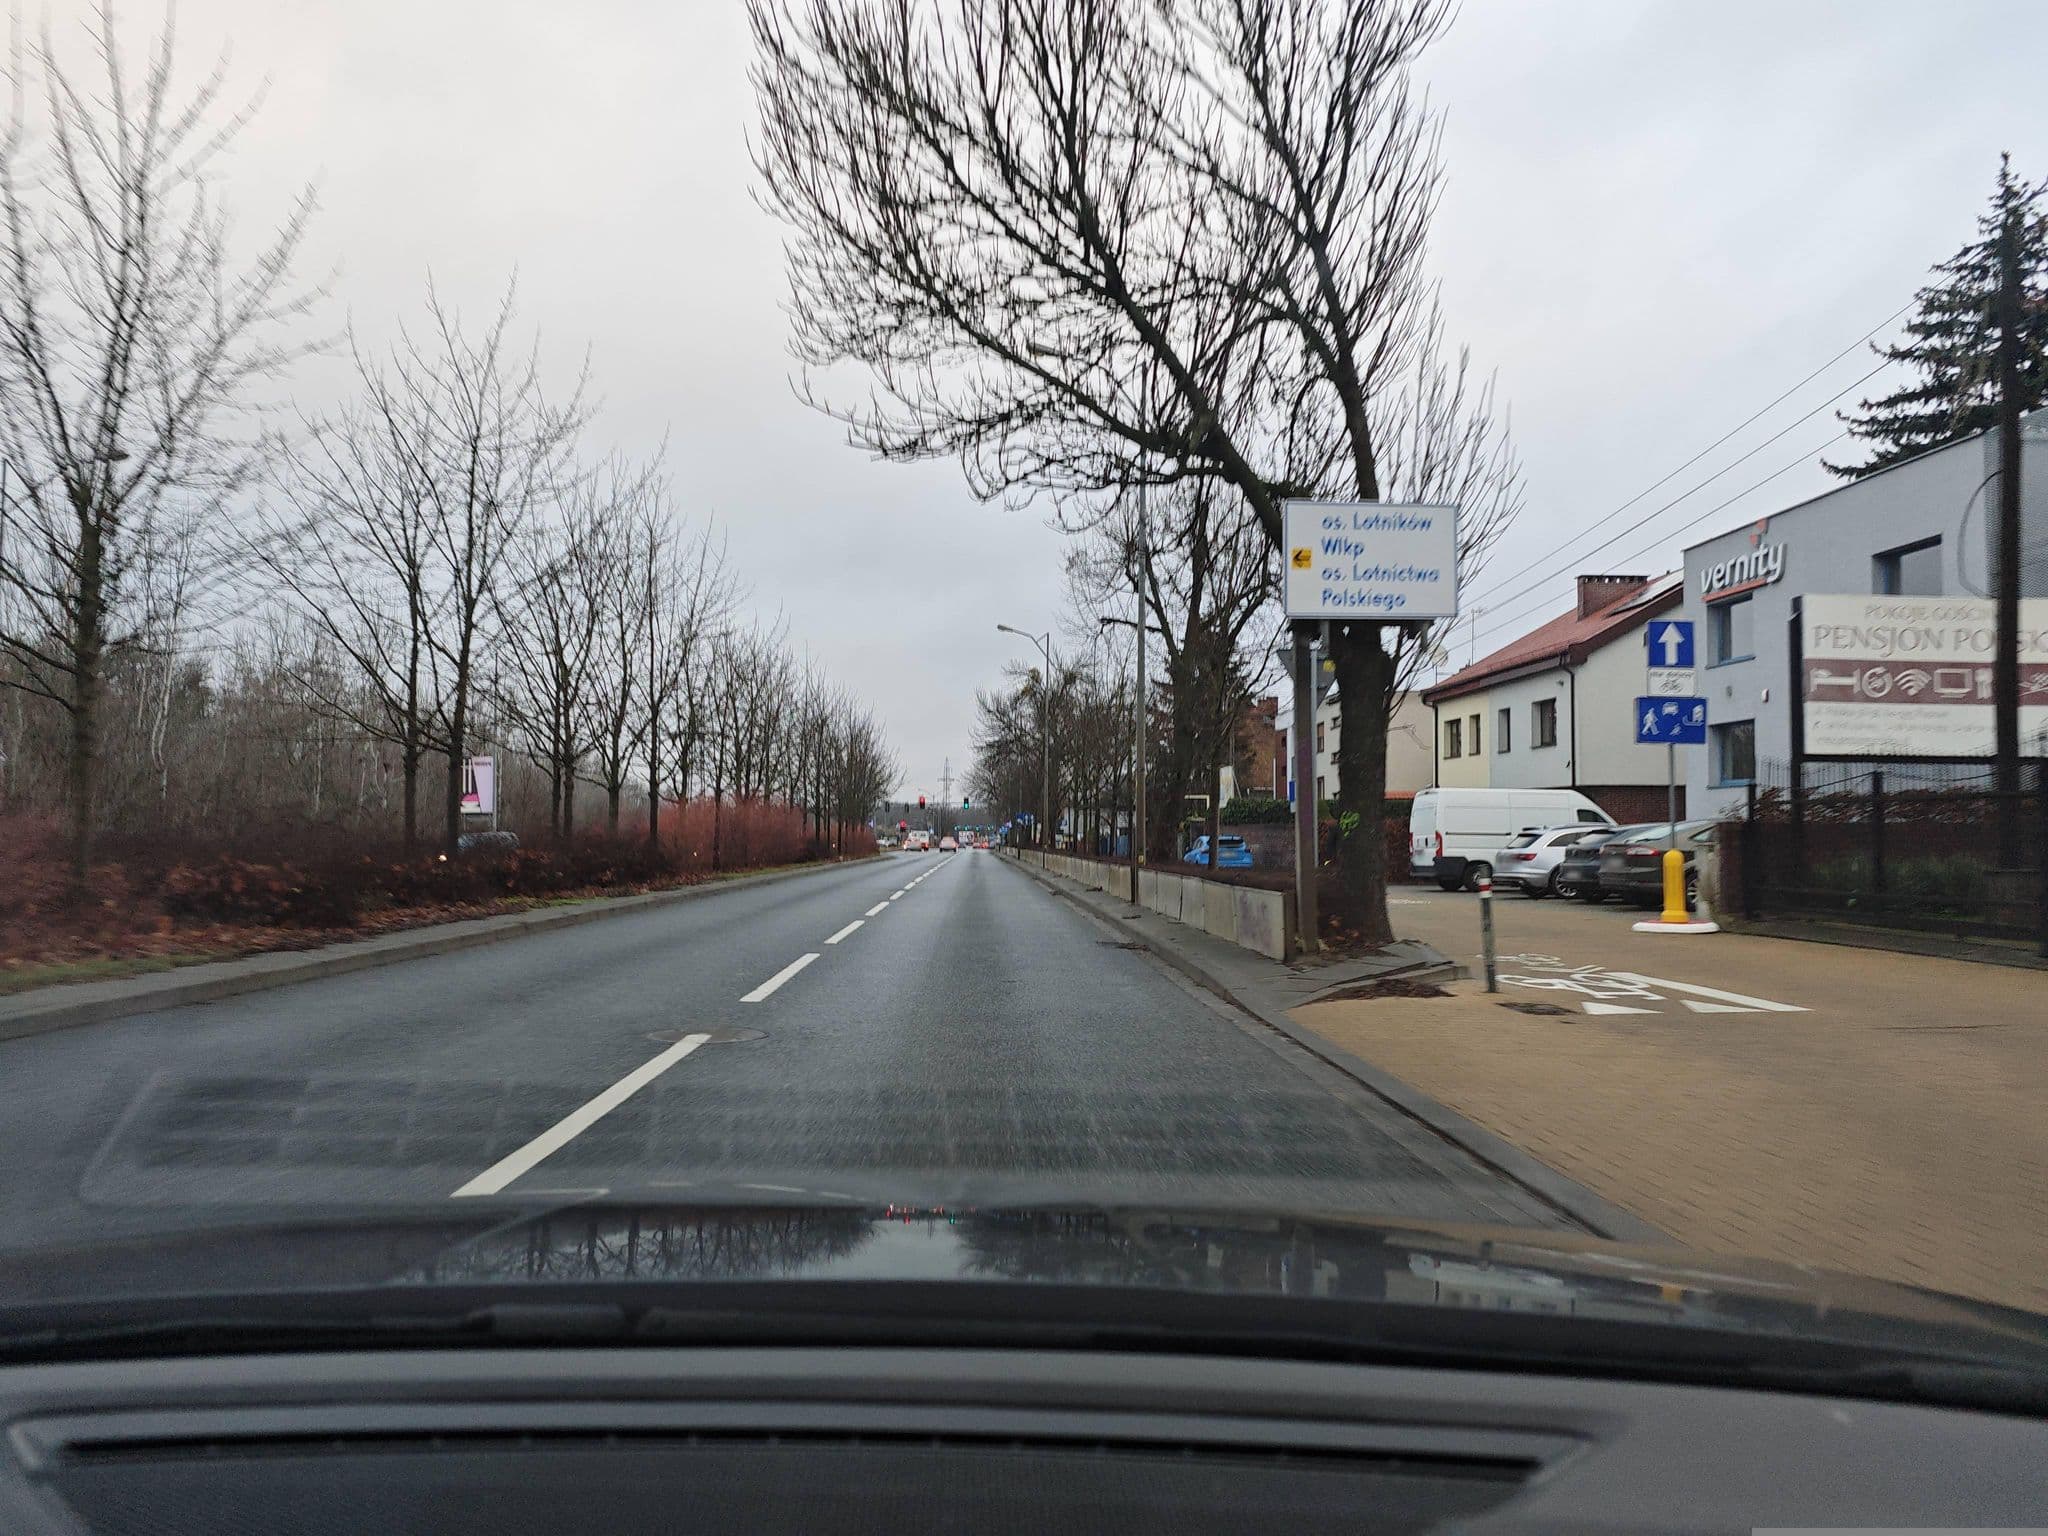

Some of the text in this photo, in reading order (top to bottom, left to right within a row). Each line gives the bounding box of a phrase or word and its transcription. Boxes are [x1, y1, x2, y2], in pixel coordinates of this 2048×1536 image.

[1322, 511, 1433, 532] os. Lotników
[1321, 536, 1365, 560] Wlkp
[1321, 563, 1440, 584] os. Lotnictwa
[1700, 542, 1782, 593] vernity
[1321, 587, 1408, 611] Polskiego
[1812, 624, 1945, 657] PENSJON
